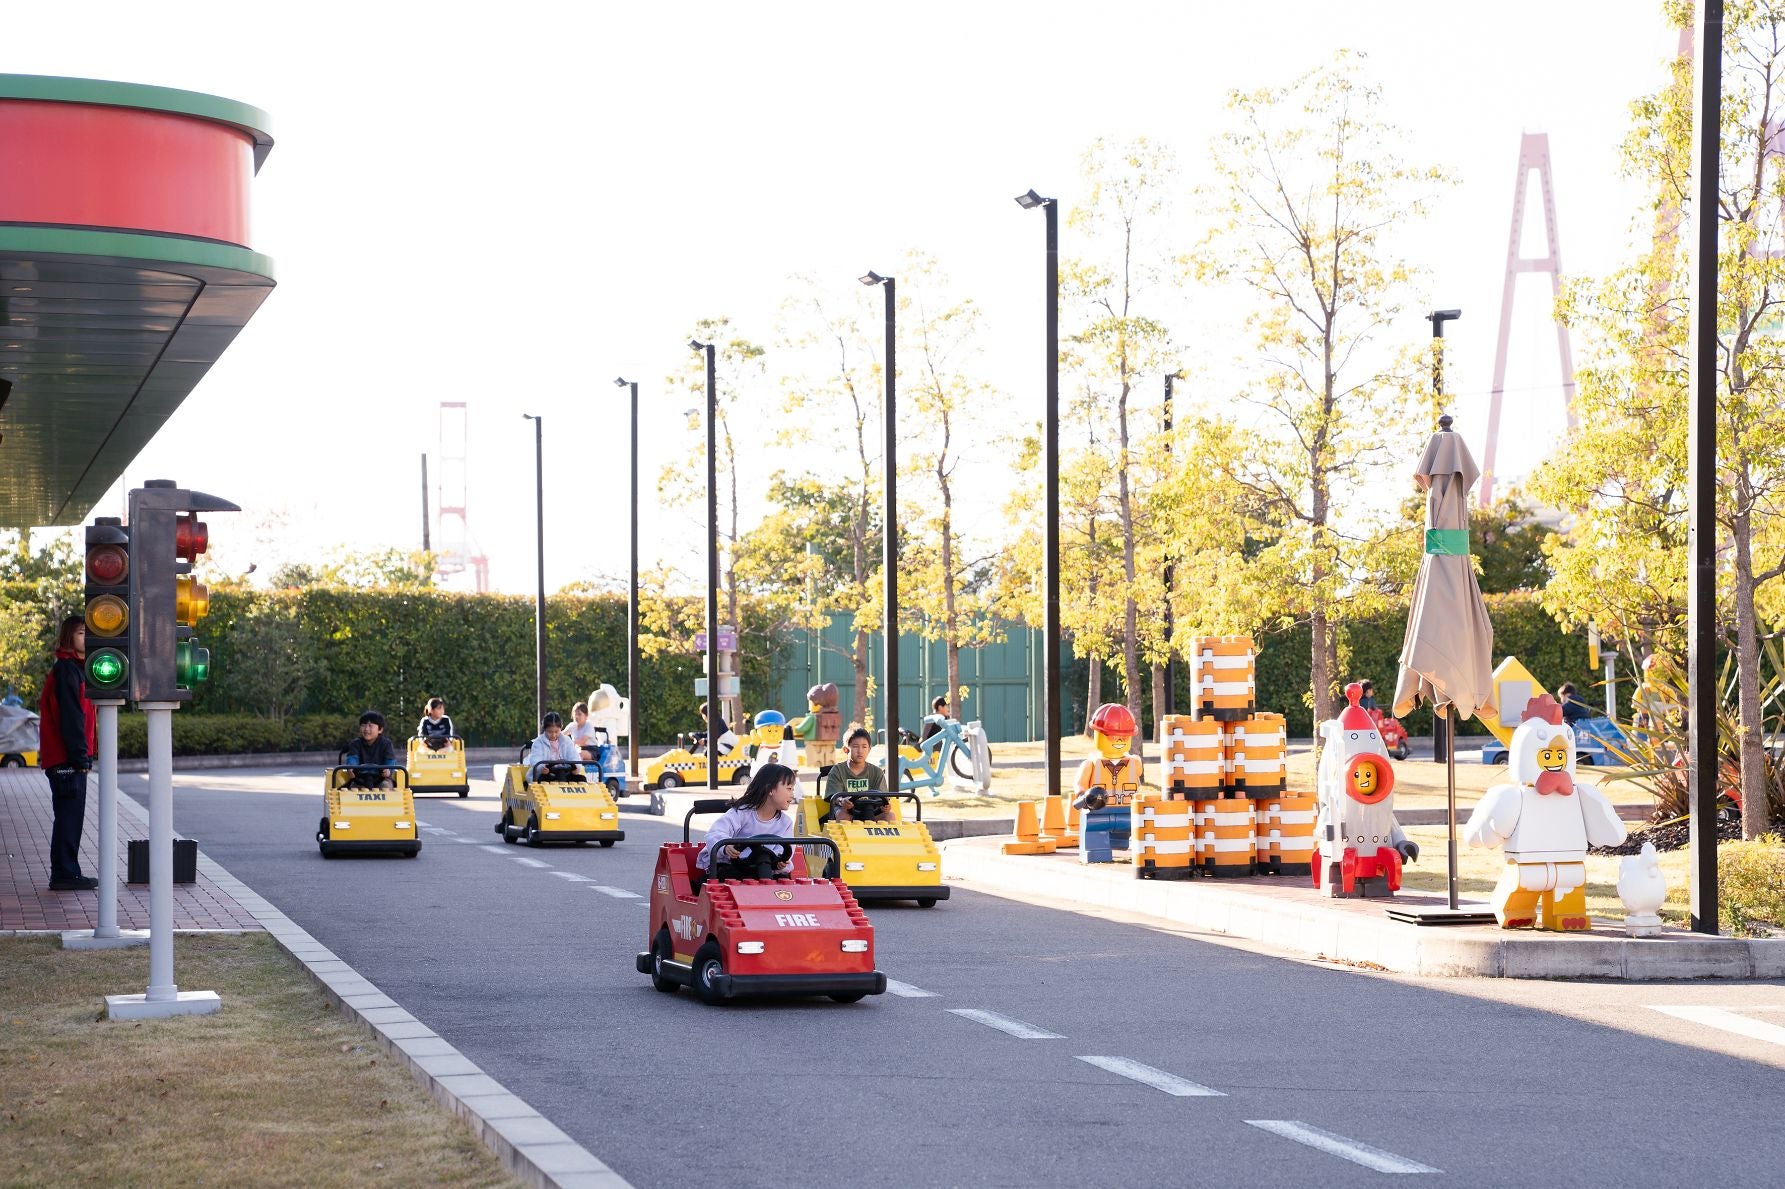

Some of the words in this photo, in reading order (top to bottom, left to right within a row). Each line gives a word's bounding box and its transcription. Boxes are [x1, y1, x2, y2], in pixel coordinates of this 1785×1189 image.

[847, 779, 868, 788] FELIX
[559, 786, 587, 794] TAXI
[357, 793, 386, 801] TAXI
[864, 827, 901, 836] TAXI
[774, 913, 820, 927] FIRE
